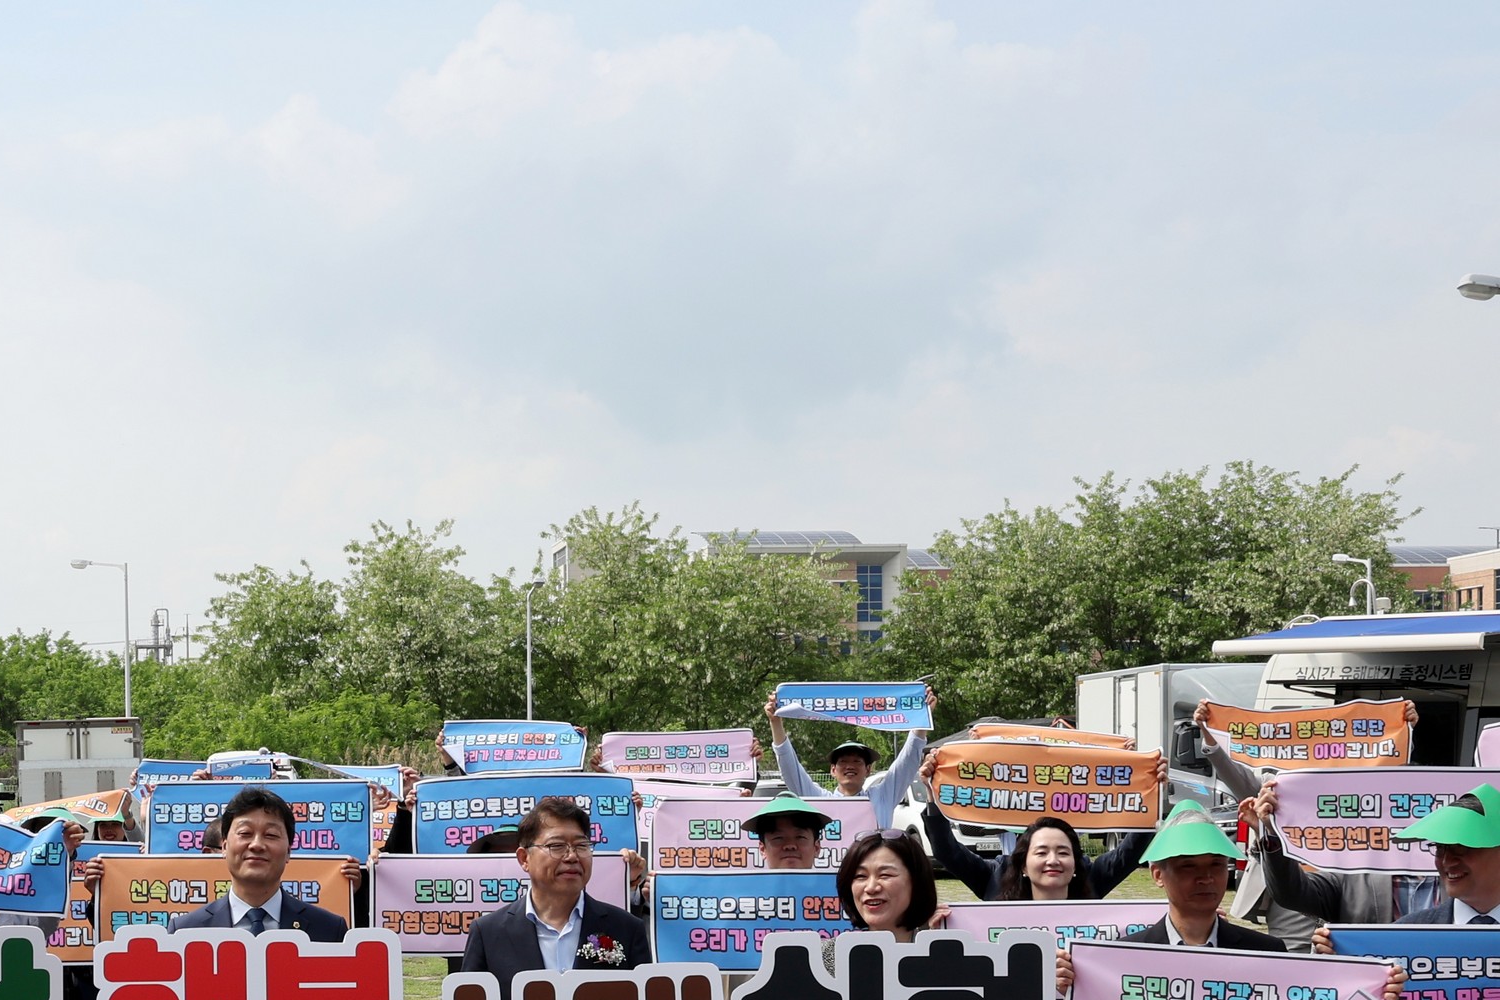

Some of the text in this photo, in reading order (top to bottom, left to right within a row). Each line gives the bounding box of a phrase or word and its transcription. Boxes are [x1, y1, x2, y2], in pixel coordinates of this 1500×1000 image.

[1399, 663, 1473, 682] 측정시스템
[863, 698, 897, 710] 안전한
[900, 697, 924, 710] 전남
[522, 733, 556, 745] 안전한
[559, 733, 582, 745] 전남
[1228, 718, 1386, 739] 신속하고 정확한 진단
[493, 748, 563, 761] 만들겠습니다.
[625, 744, 729, 760] 도민의 건강과 안전
[1314, 739, 1400, 760] 이어갑니다.
[614, 761, 749, 774] 염병센터가 함께 합니다.
[957, 762, 1132, 785] 신속하고 정확한 진단
[420, 796, 535, 821] 감염병으로부터
[597, 796, 630, 816] 전남
[939, 784, 1148, 813] 동부권에서도 이어갑니다.
[1317, 794, 1382, 818] 도민의
[154, 801, 364, 823] 감염병으 전한 전남
[688, 819, 741, 840] 도민의
[819, 819, 842, 840] 전
[30, 842, 65, 865] 전남
[130, 880, 207, 903] 신속하고
[415, 879, 473, 903] 도민의
[70, 900, 88, 920] 진
[661, 896, 849, 920] 감염병으로부터 안전
[689, 928, 748, 952] 우리가
